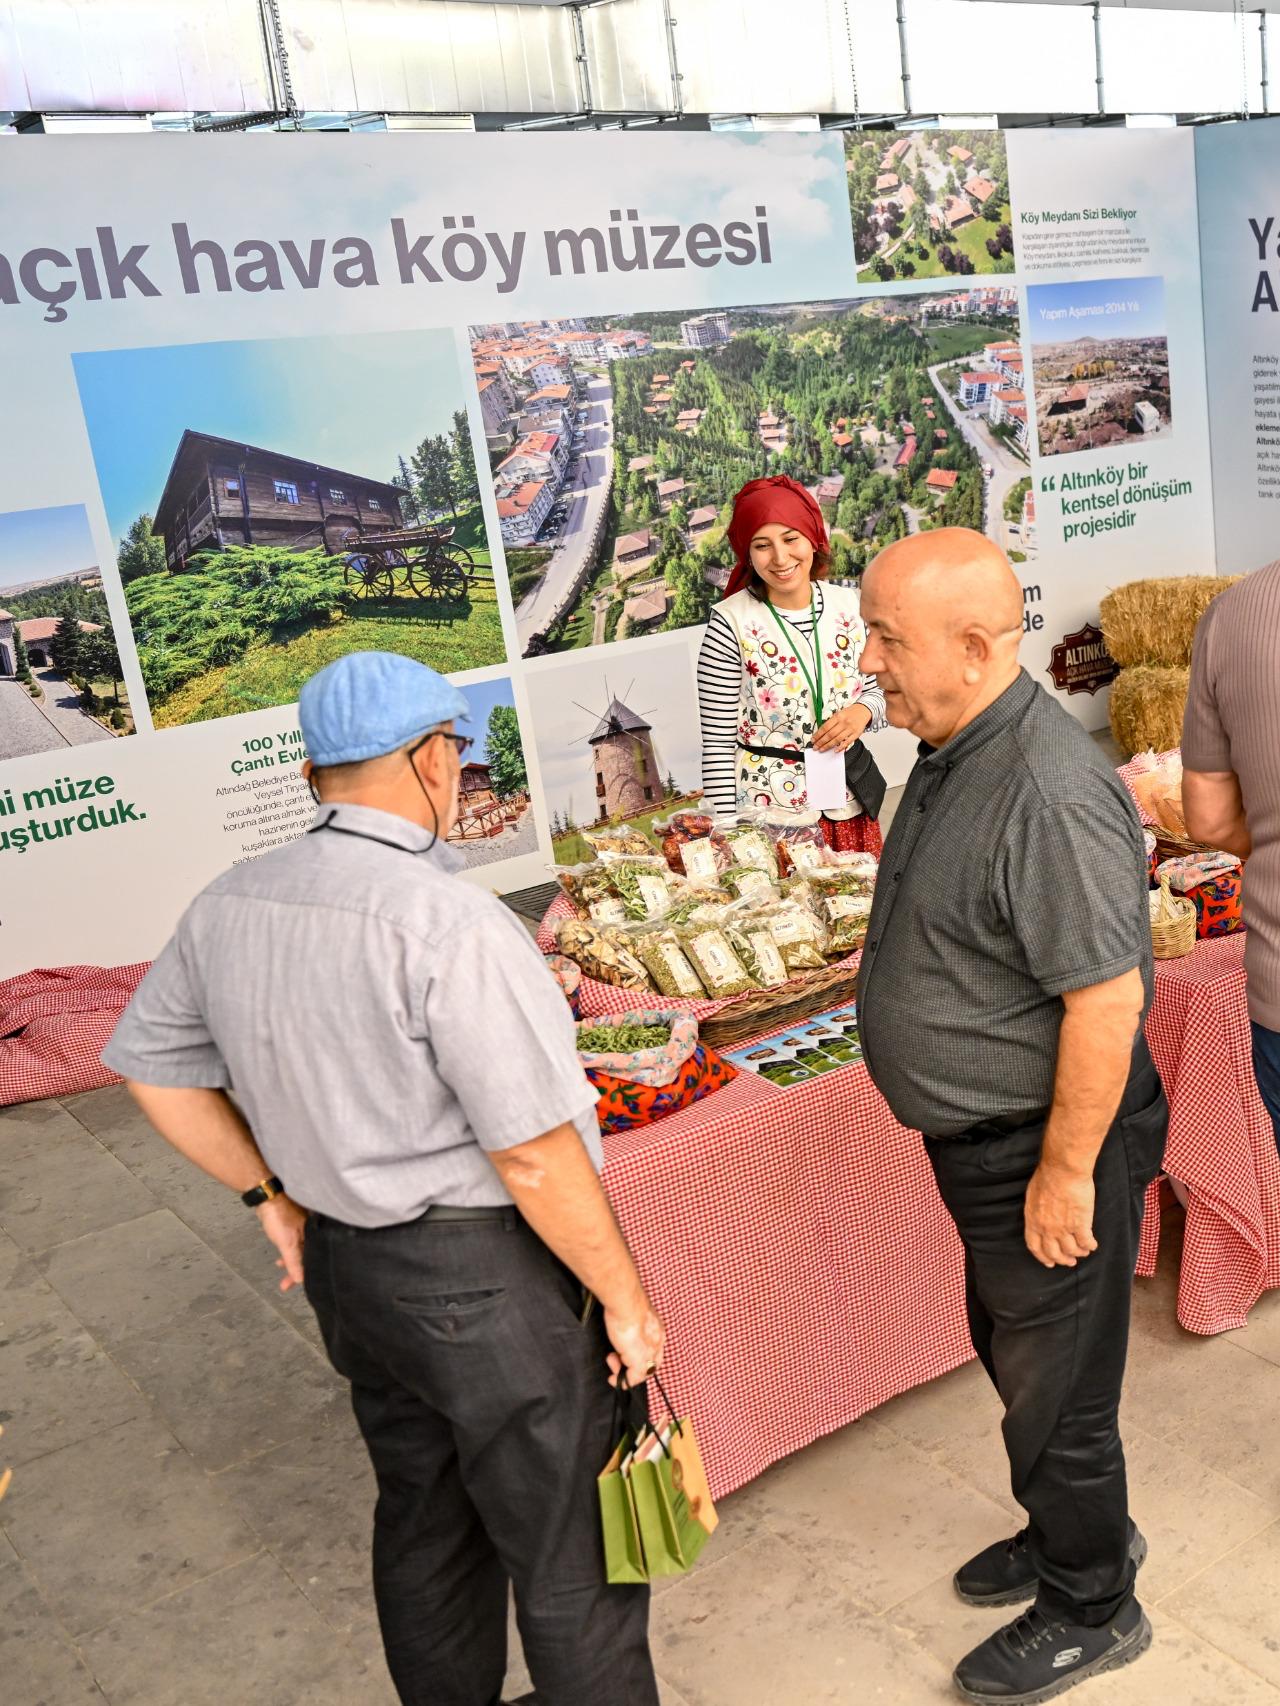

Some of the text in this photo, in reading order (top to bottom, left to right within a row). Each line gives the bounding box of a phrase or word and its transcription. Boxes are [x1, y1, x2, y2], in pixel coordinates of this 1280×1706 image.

[1020, 207, 1137, 225] Köy Meydanı Sizi Bekliyor
[171, 222, 380, 295] hava
[390, 215, 527, 294] köy
[543, 205, 772, 276] müzesi
[1060, 466, 1125, 492] Altınköy
[1128, 461, 1148, 481] bir
[1061, 479, 1193, 516] kentsel dönüşüm
[1063, 509, 1137, 543] projesidir
[242, 737, 273, 753] 100
[231, 755, 275, 776] Çantı
[22, 776, 115, 811] müze
[215, 782, 252, 797] Altındağ
[251, 775, 289, 790] Belediye
[254, 787, 284, 801] Veysel
[285, 795, 305, 808] çantı
[223, 818, 258, 833] koruma
[258, 813, 281, 825] altına
[281, 807, 306, 819] almak
[258, 821, 299, 837] hazinenin
[241, 837, 283, 853] kuşaklara
